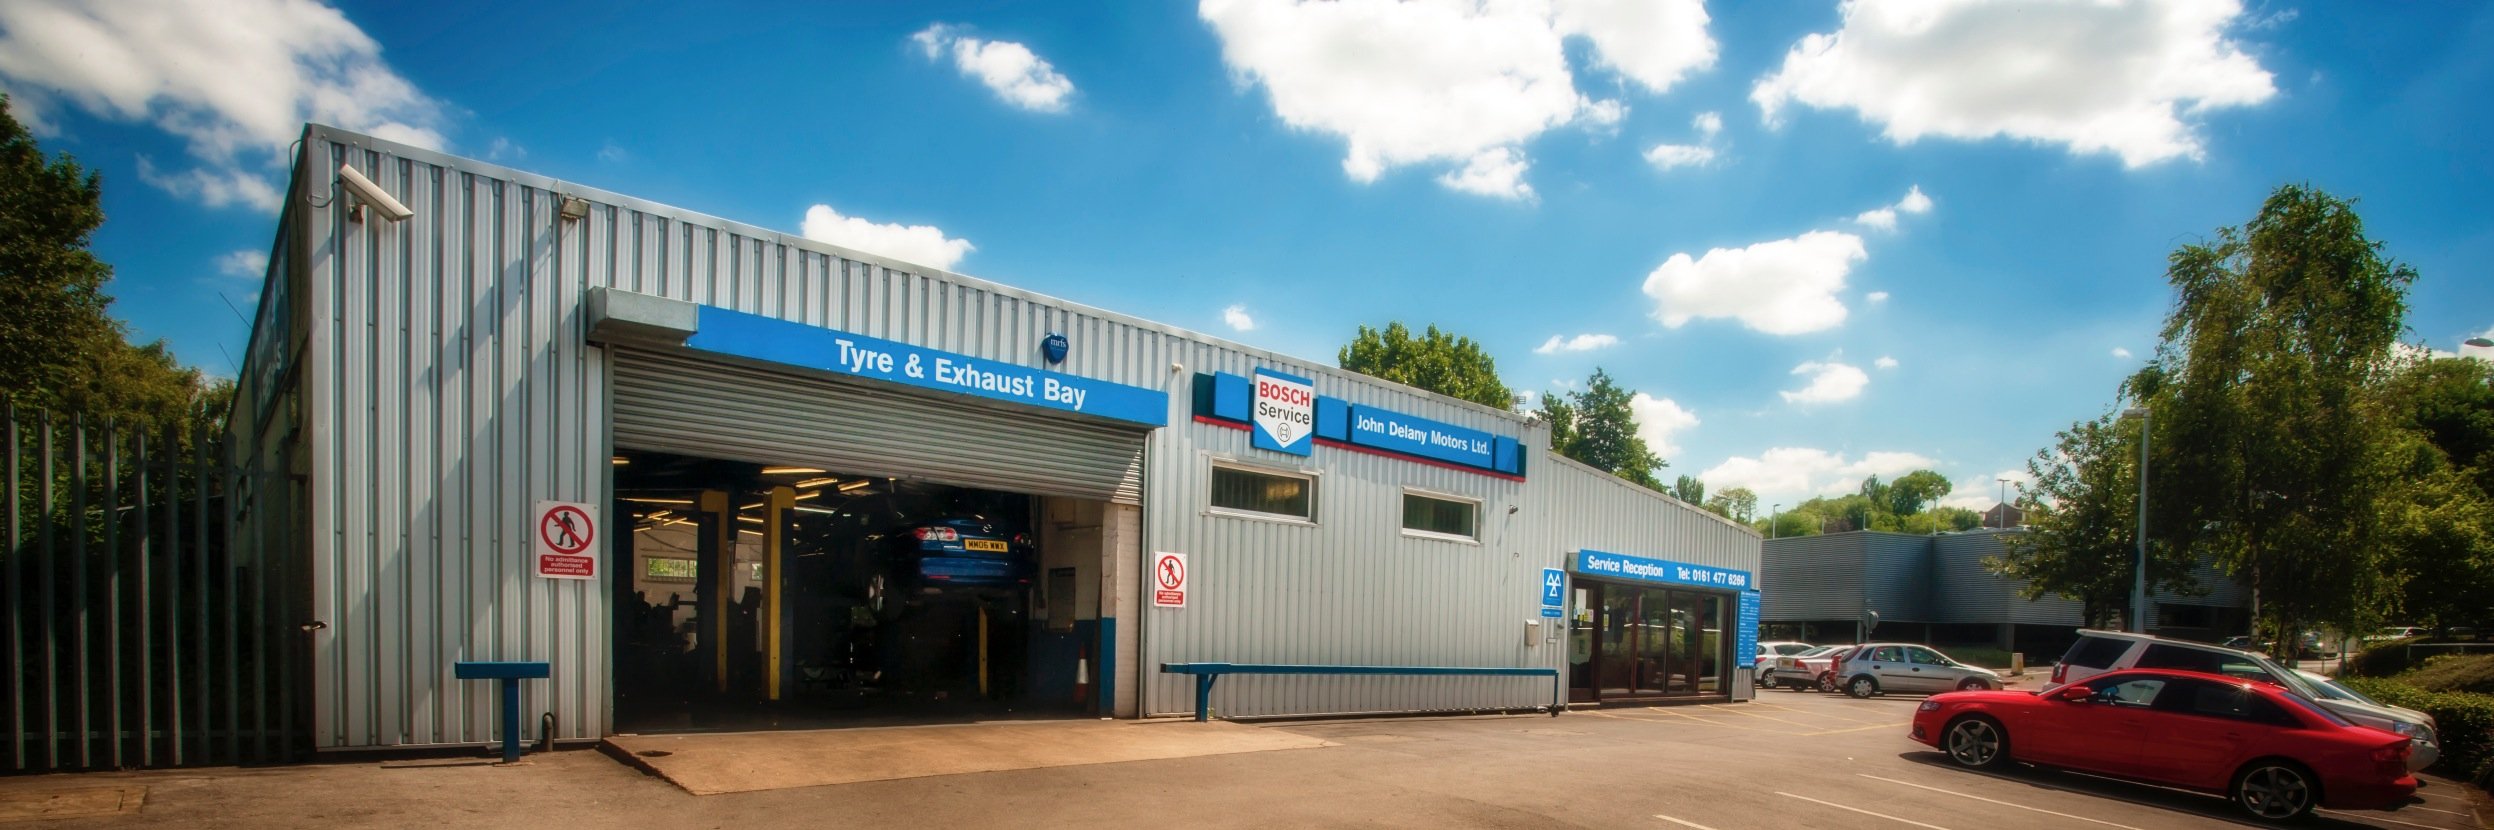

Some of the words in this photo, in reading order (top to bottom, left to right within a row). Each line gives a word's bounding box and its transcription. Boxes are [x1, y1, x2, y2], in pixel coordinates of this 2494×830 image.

[835, 339, 893, 374] Tyre
[905, 354, 924, 379] &
[934, 357, 1034, 398] Exhaust
[1043, 378, 1087, 410] Bay
[1259, 381, 1310, 407] BOSCH
[1258, 402, 1310, 425] Service
[1357, 415, 1385, 434] John
[1389, 422, 1427, 443] Delany
[1431, 431, 1468, 452] Motors
[1471, 440, 1490, 456] Ltd.
[1587, 555, 1620, 573] Service
[1622, 559, 1664, 578] Reception
[1677, 566, 1690, 580] Tel:
[1692, 569, 1711, 583] 0161
[1712, 571, 1726, 584] 477
